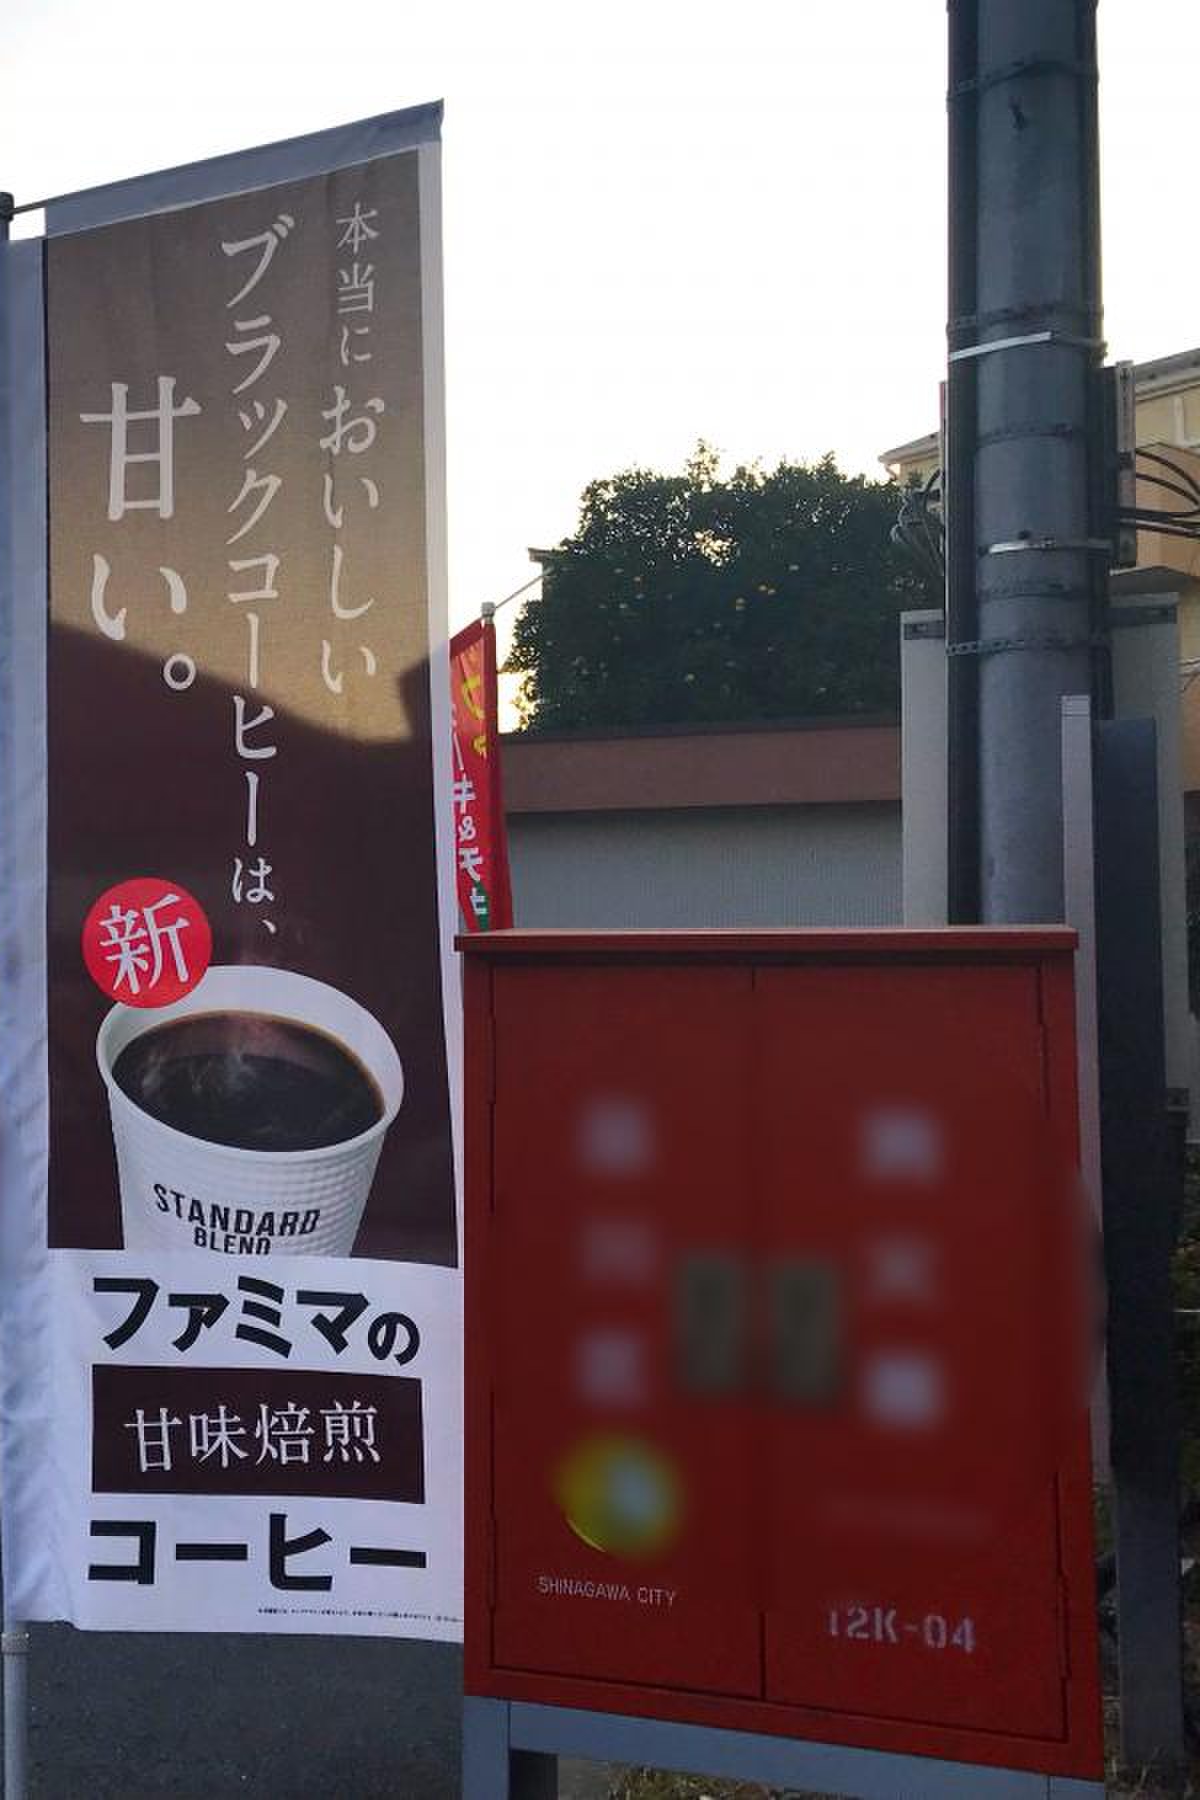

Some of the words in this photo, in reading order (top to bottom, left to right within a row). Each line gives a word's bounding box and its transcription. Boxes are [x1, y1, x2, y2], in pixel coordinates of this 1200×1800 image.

[319, 201, 385, 693] 本当においしい
[79, 376, 201, 691] 甘い。
[221, 213, 294, 934] ブラックコーヒーは、
[99, 894, 190, 995] 新
[153, 1183, 321, 1237] STANDARD
[194, 1227, 271, 1255] BLEND
[92, 1275, 421, 1365] ファミマの
[124, 1400, 382, 1473] 甘味焙煎
[88, 1513, 428, 1592] コーヒー
[538, 1576, 631, 1600] SHINAGAWA
[638, 1586, 677, 1607] CITY
[829, 1606, 977, 1653] 12K-04
